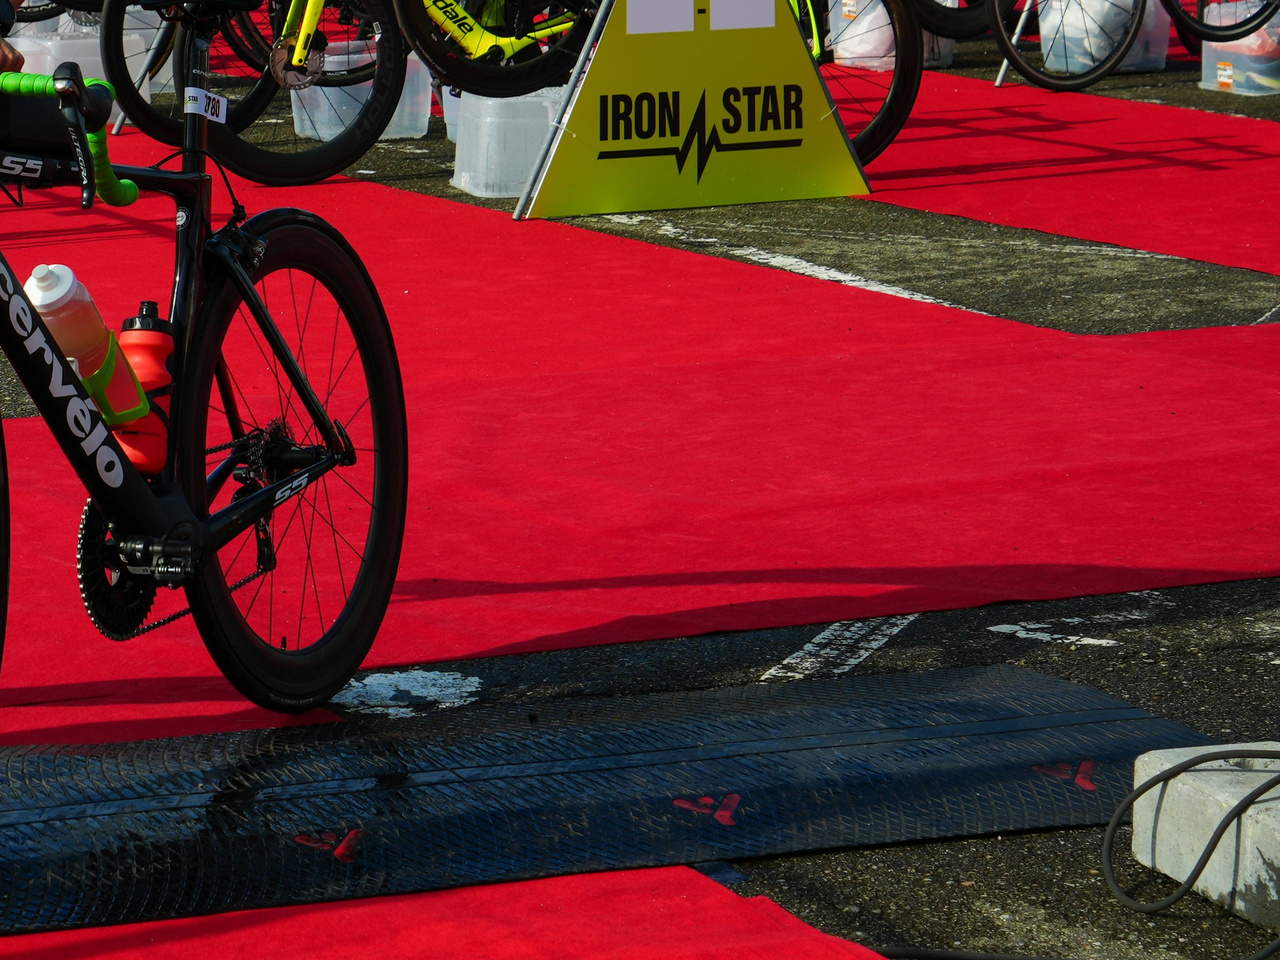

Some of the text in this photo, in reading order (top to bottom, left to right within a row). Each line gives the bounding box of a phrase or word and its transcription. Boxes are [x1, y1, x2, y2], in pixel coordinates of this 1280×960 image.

[599, 84, 804, 141] IRON STAR
[68, 127, 88, 185] ULTEGRA
[273, 472, 309, 506] S5
